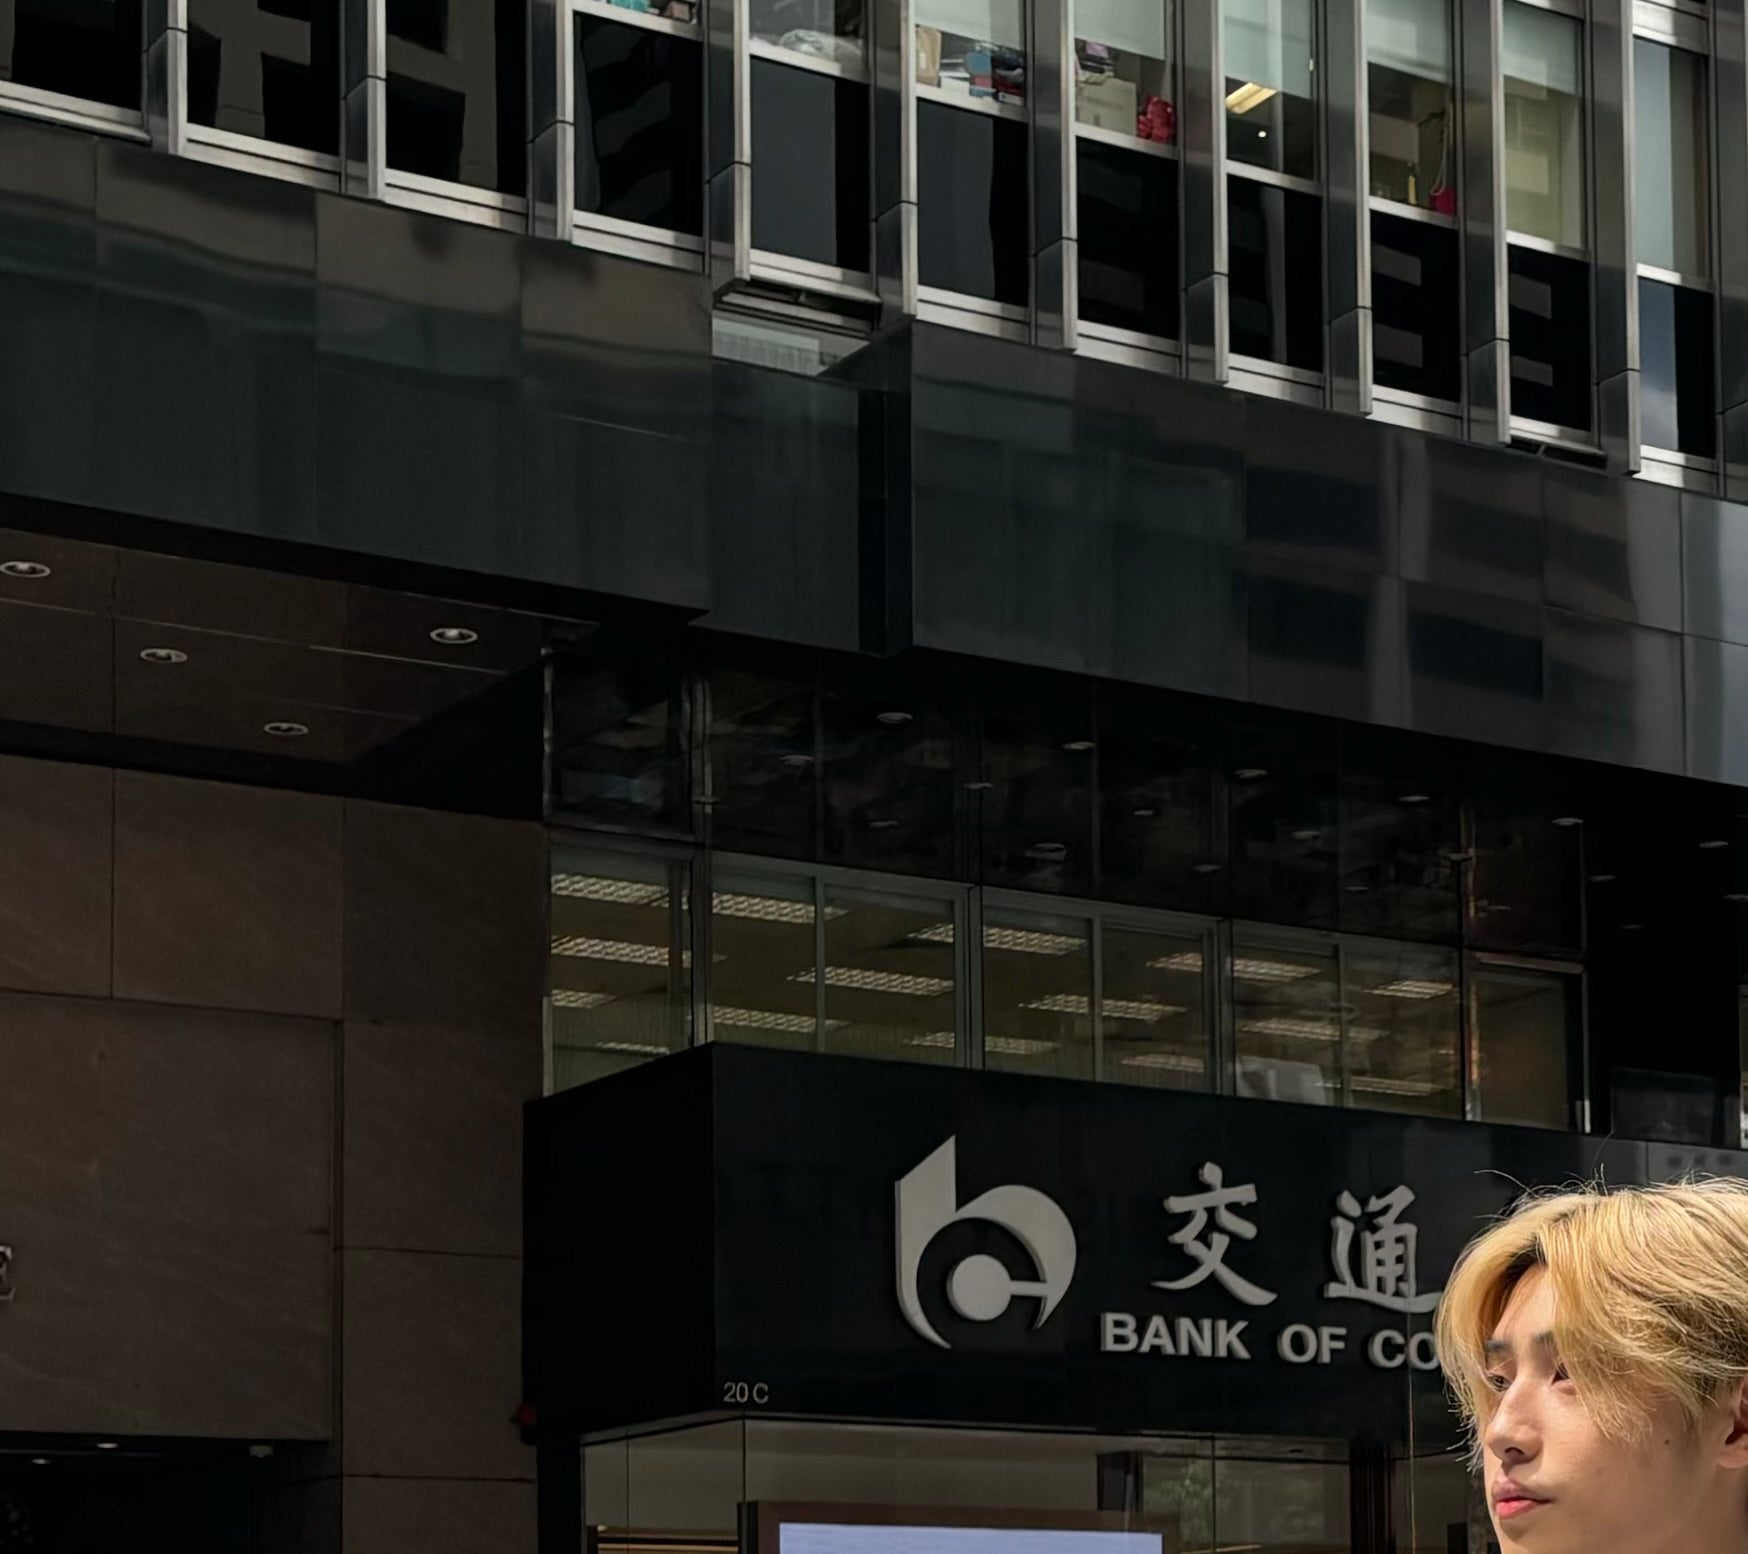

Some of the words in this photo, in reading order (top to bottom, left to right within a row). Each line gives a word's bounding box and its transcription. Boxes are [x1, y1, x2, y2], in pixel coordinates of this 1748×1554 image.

[1150, 1161, 1443, 1315] 交通
[1101, 1311, 1252, 1361] BANK
[1277, 1323, 1348, 1365] OF
